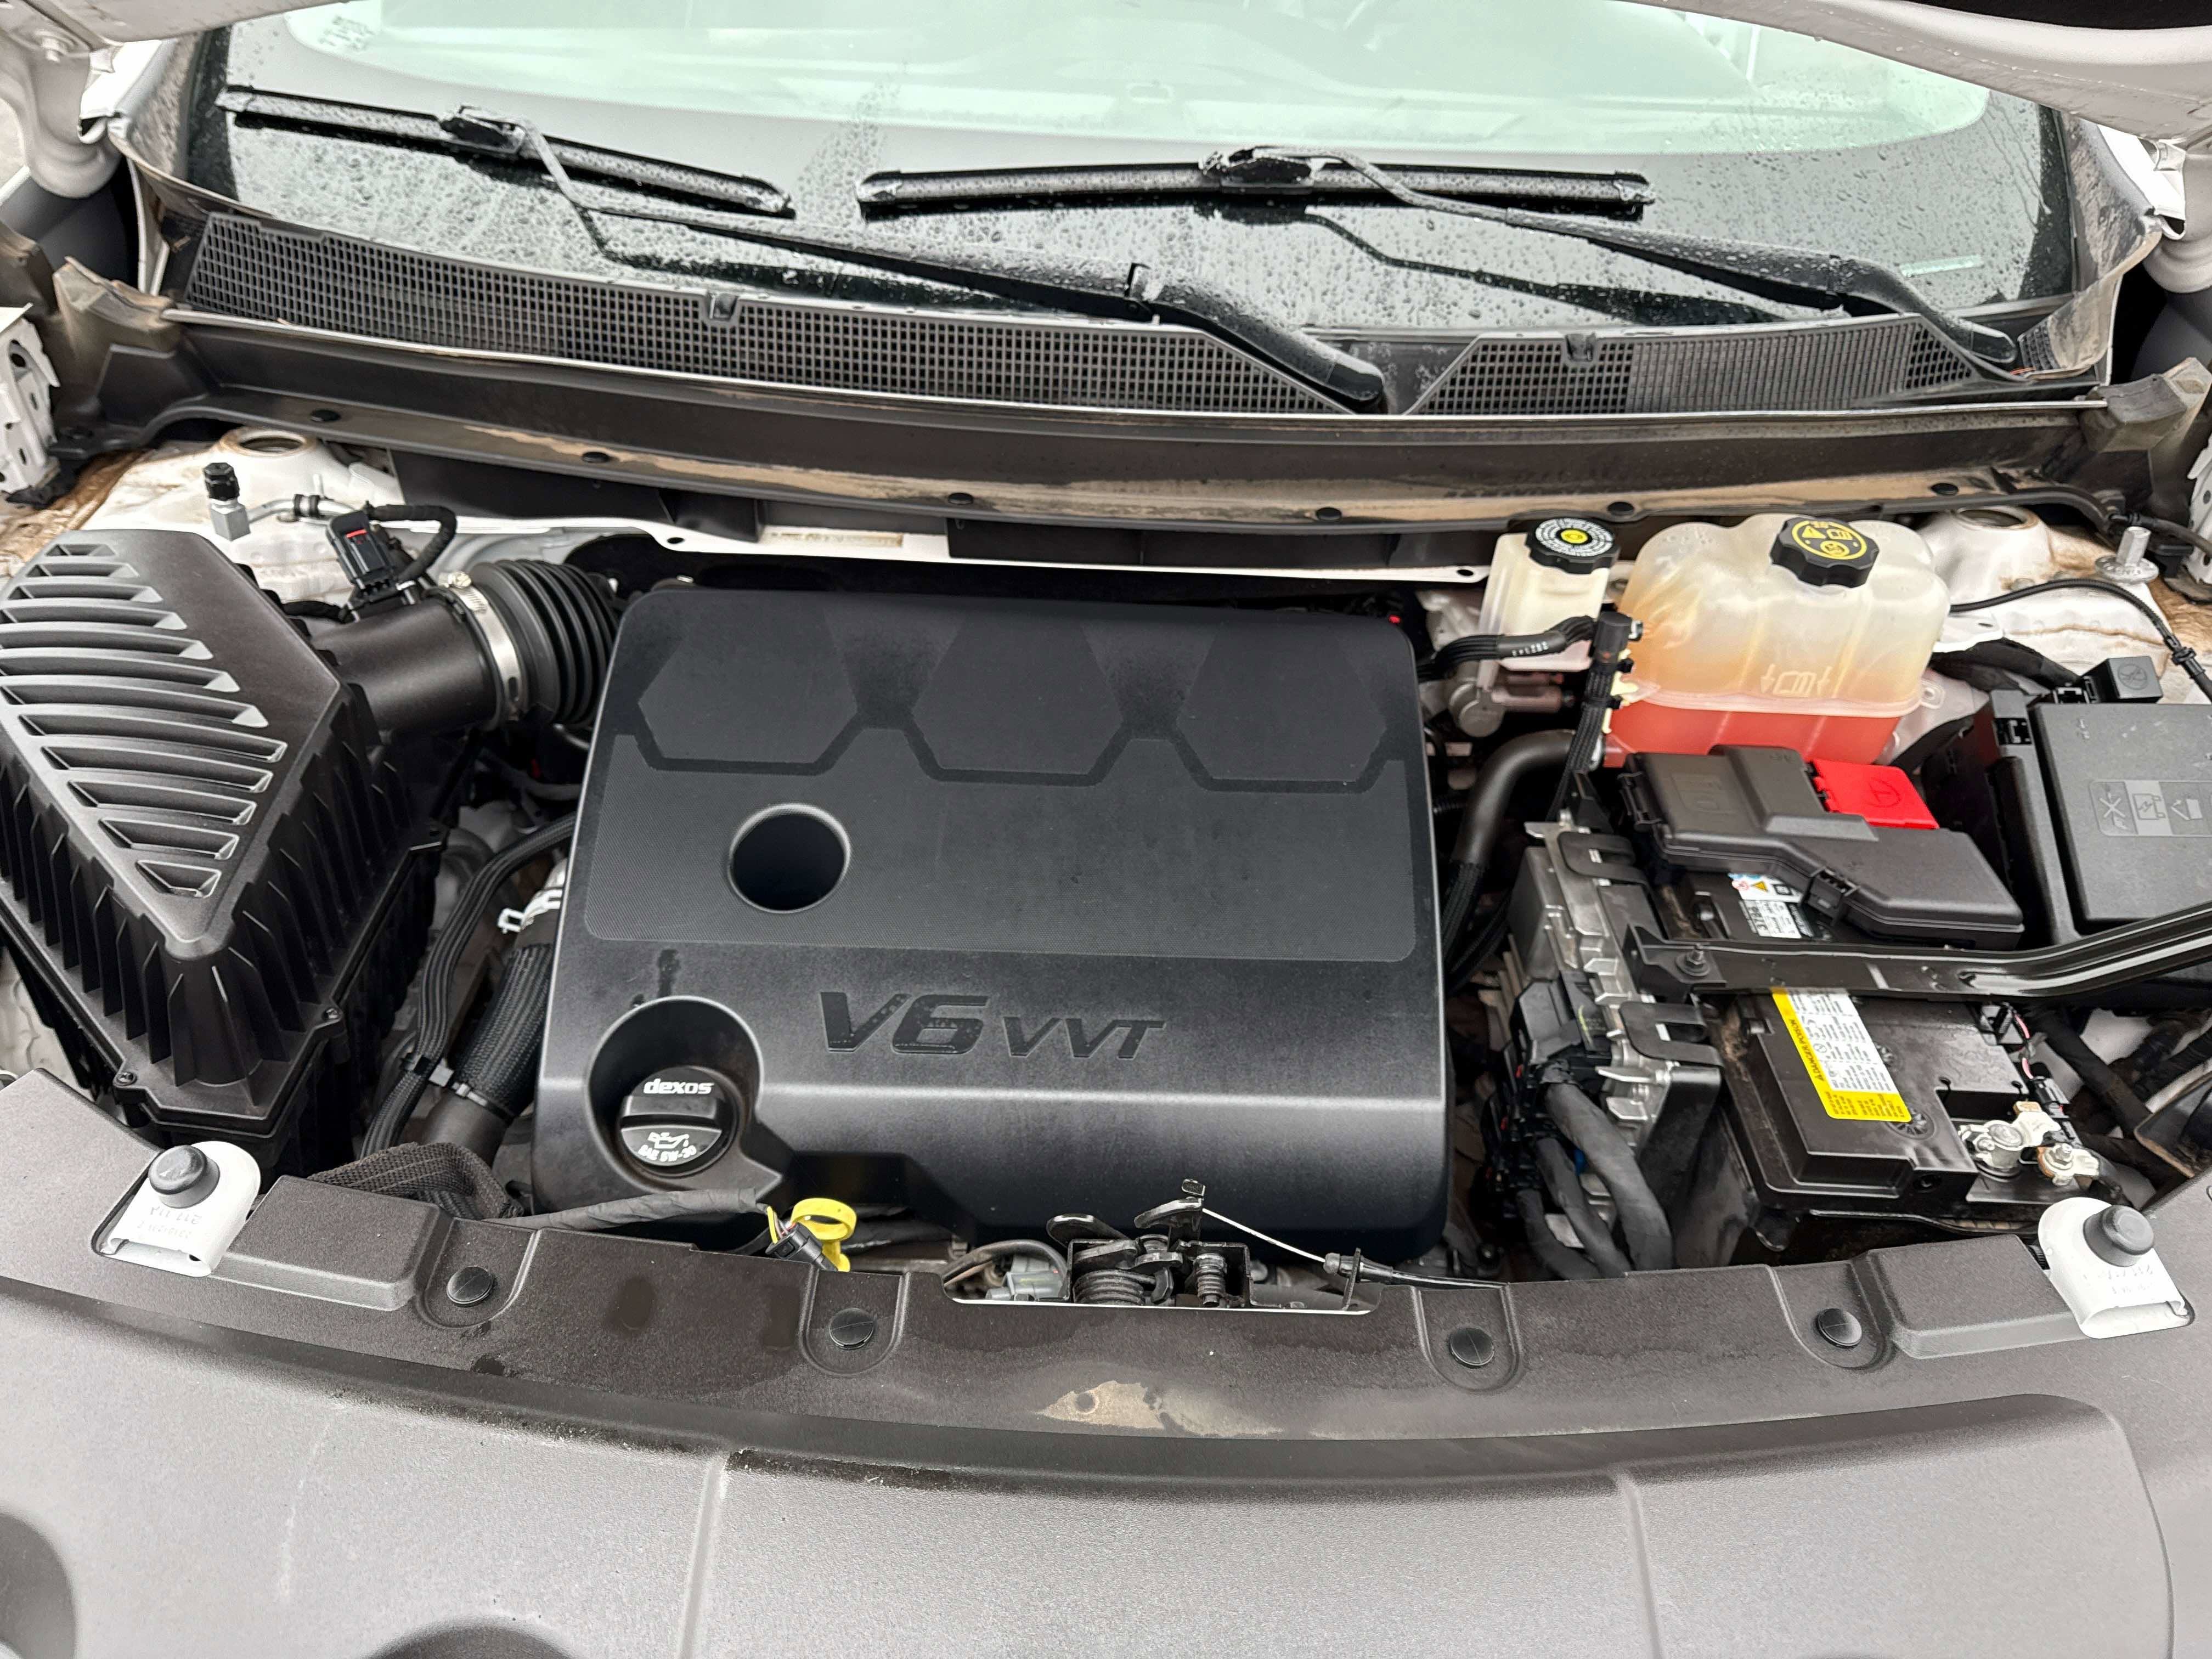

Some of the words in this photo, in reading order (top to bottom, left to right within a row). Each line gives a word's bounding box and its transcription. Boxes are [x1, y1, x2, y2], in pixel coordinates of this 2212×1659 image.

[820, 992, 988, 1054] V6
[1003, 1017, 1168, 1059] VVT
[643, 1078, 714, 1094] dexos
